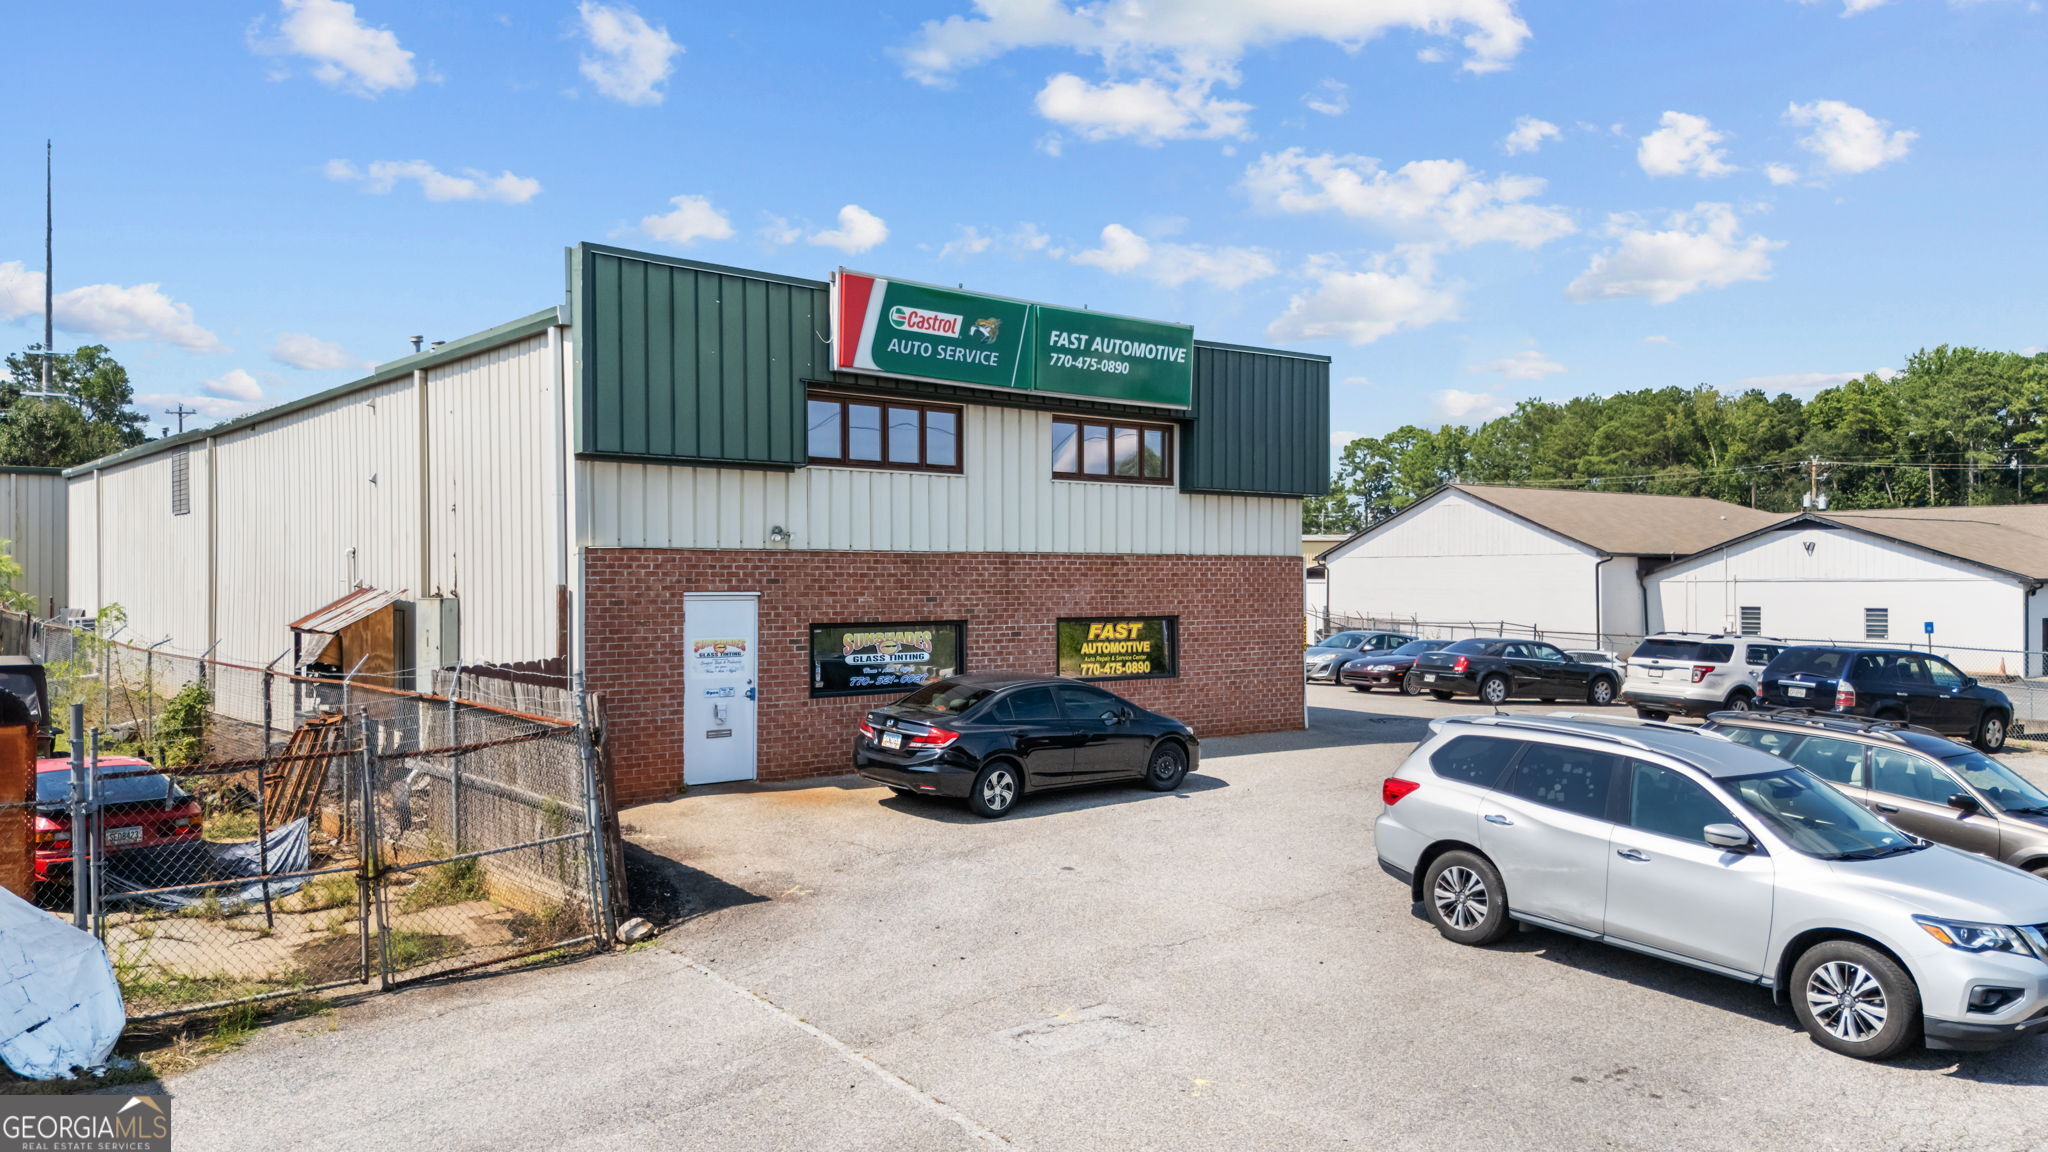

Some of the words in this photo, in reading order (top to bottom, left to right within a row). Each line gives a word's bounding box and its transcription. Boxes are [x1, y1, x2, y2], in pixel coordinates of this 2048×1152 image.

[907, 310, 957, 335] Castrol
[887, 338, 932, 357] AUTO
[936, 345, 1000, 366] SERVICE
[1050, 330, 1089, 350] FAST
[1091, 336, 1187, 363] AUTOMOTIVE
[1050, 353, 1130, 375] 770-475-0890
[1087, 622, 1144, 640] FAST
[843, 631, 932, 656] SUNSHADES
[1080, 641, 1151, 655] AUTOMOTIVE
[853, 654, 886, 663] GLASS
[889, 652, 925, 661] TINTING
[1080, 661, 1151, 676] 770-475-0890
